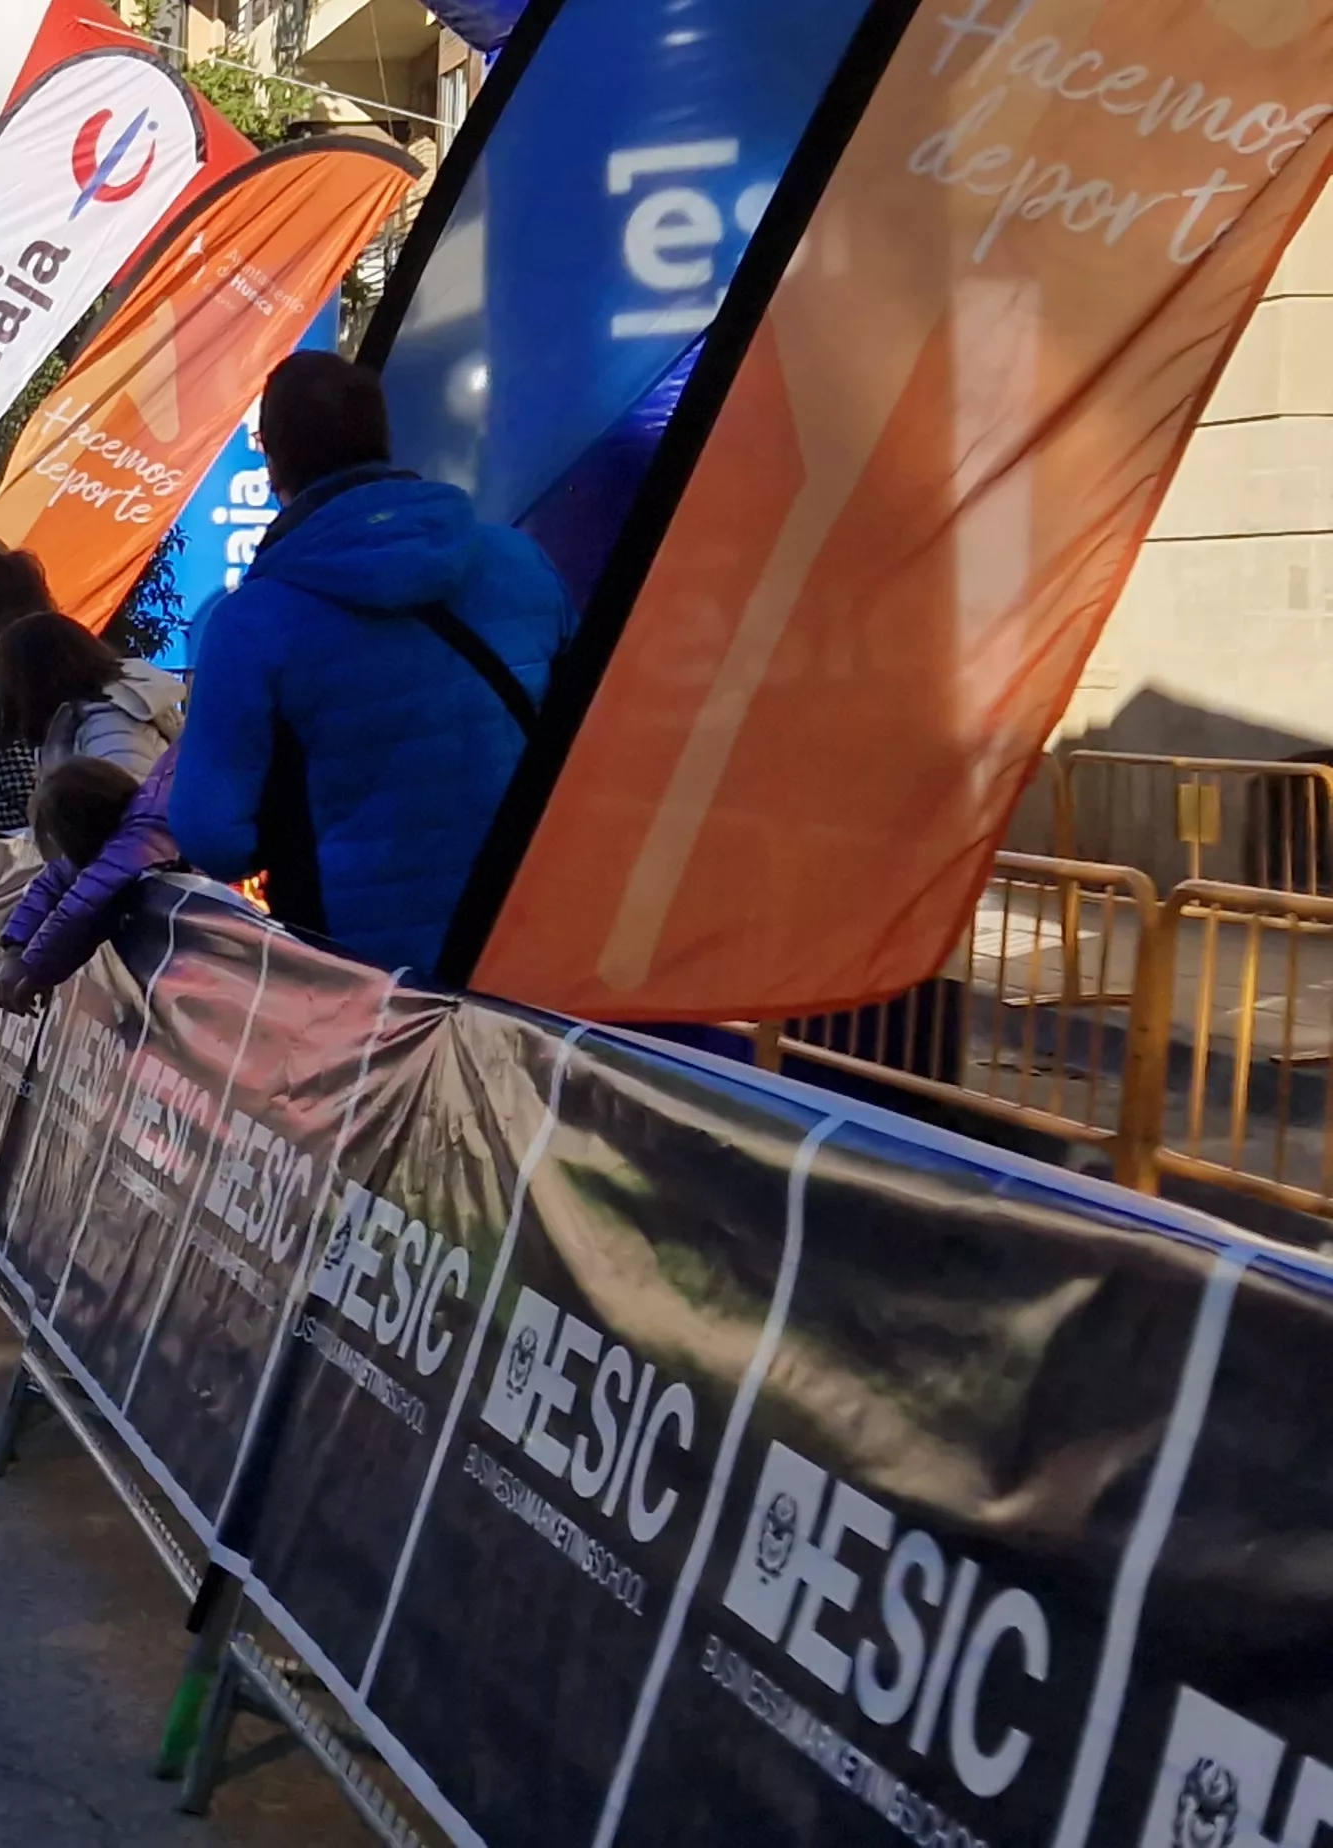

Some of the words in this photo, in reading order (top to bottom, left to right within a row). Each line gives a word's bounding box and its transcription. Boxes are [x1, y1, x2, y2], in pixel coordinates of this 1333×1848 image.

[905, 84, 1249, 265] deport
[40, 396, 183, 496] Hacemos
[225, 1120, 314, 1263] ESIC
[340, 1195, 470, 1377] ESIC
[524, 1312, 695, 1543] ESIC
[785, 1479, 1052, 1798] ESIC
